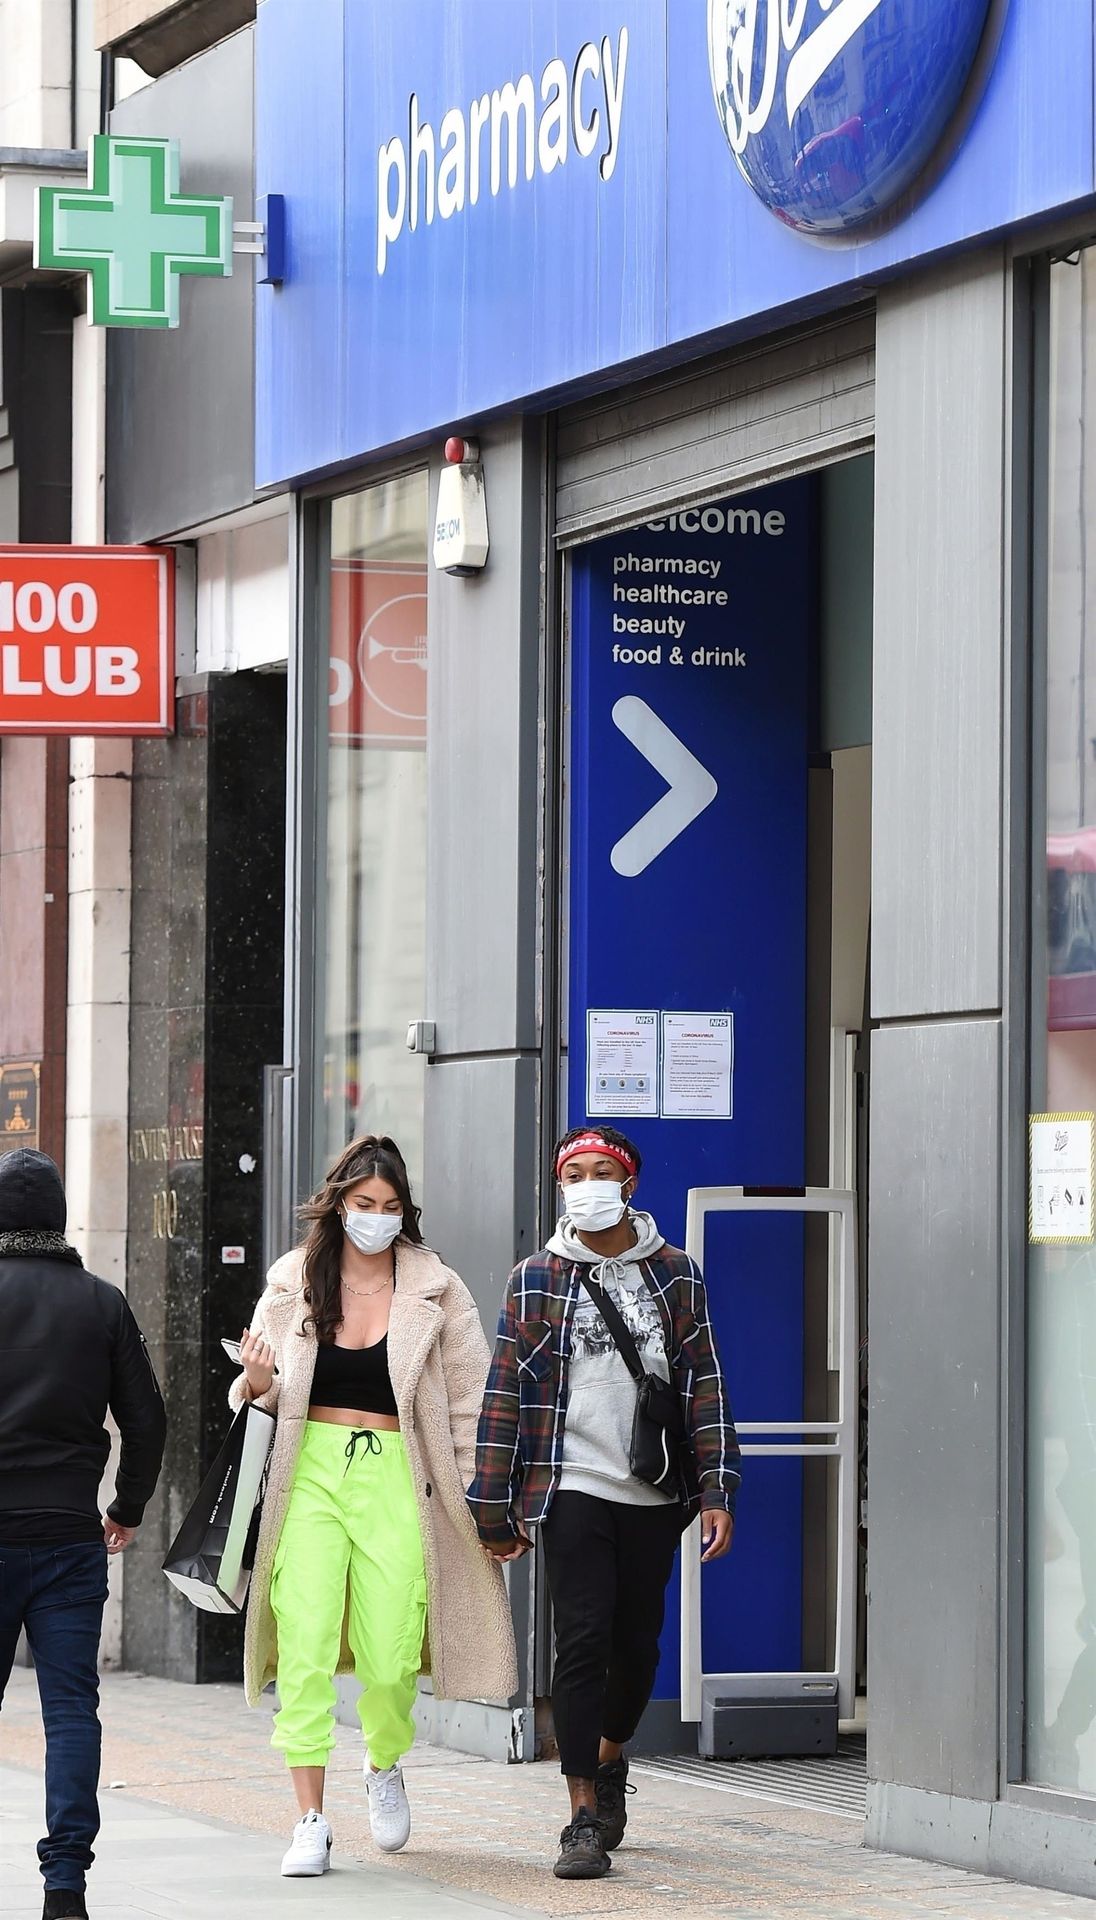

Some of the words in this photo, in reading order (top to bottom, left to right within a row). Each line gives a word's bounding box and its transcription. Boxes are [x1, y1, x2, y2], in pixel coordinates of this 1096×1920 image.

[377, 25, 629, 276] pharmacy
[613, 552, 721, 579] pharmacy
[613, 582, 728, 606] healthcare
[0, 581, 98, 634] 100
[612, 613, 686, 639] beauty
[612, 644, 661, 665] food
[668, 646, 684, 665] &
[691, 646, 746, 667] drink
[636, 1016, 654, 1024] NHS
[710, 1019, 728, 1027] NHS
